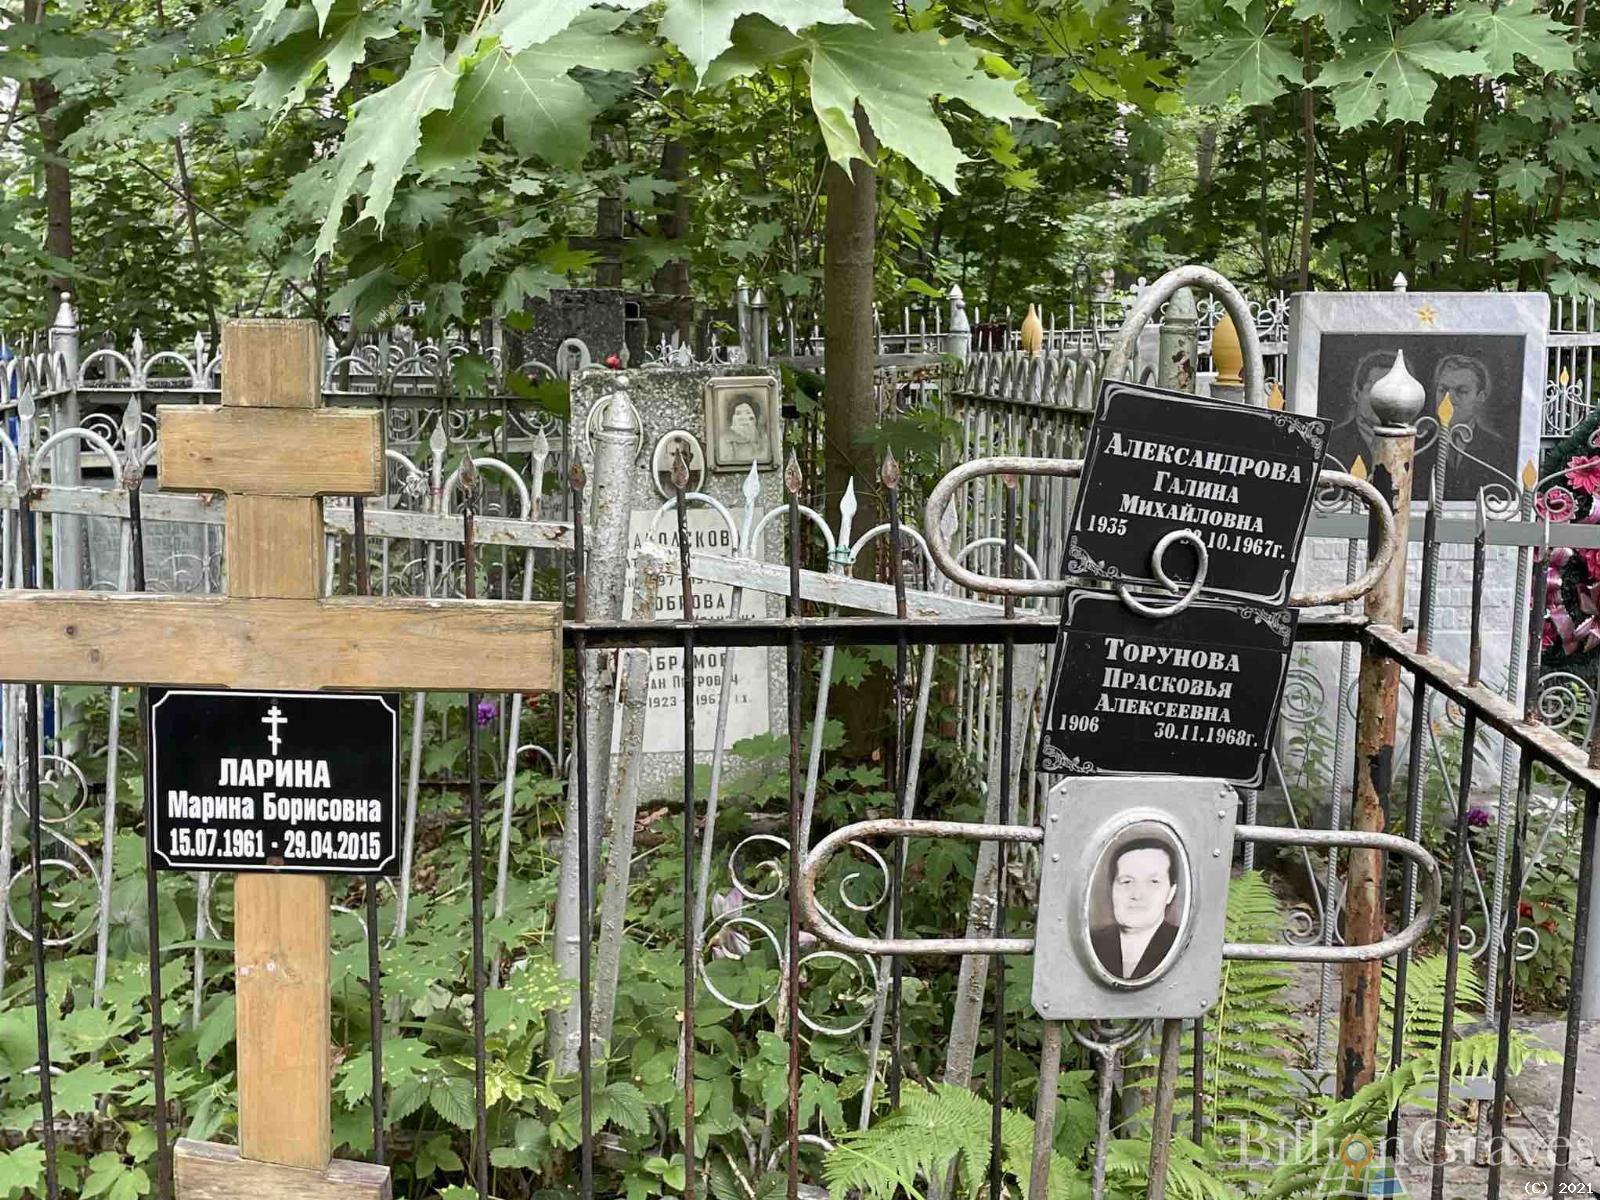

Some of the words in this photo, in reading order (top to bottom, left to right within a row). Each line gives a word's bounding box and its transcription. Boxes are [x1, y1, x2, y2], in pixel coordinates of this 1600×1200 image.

[1087, 514, 1129, 536] 1935
[1059, 714, 1100, 733] 1906
[1154, 722, 1258, 748] 30.11.1968г.
[218, 758, 331, 788] ЛАРИНА
[168, 790, 254, 824] Марина
[263, 792, 382, 825] Борисовна
[170, 828, 265, 858] 15.07.1961
[284, 830, 381, 860] 29.04.2015
